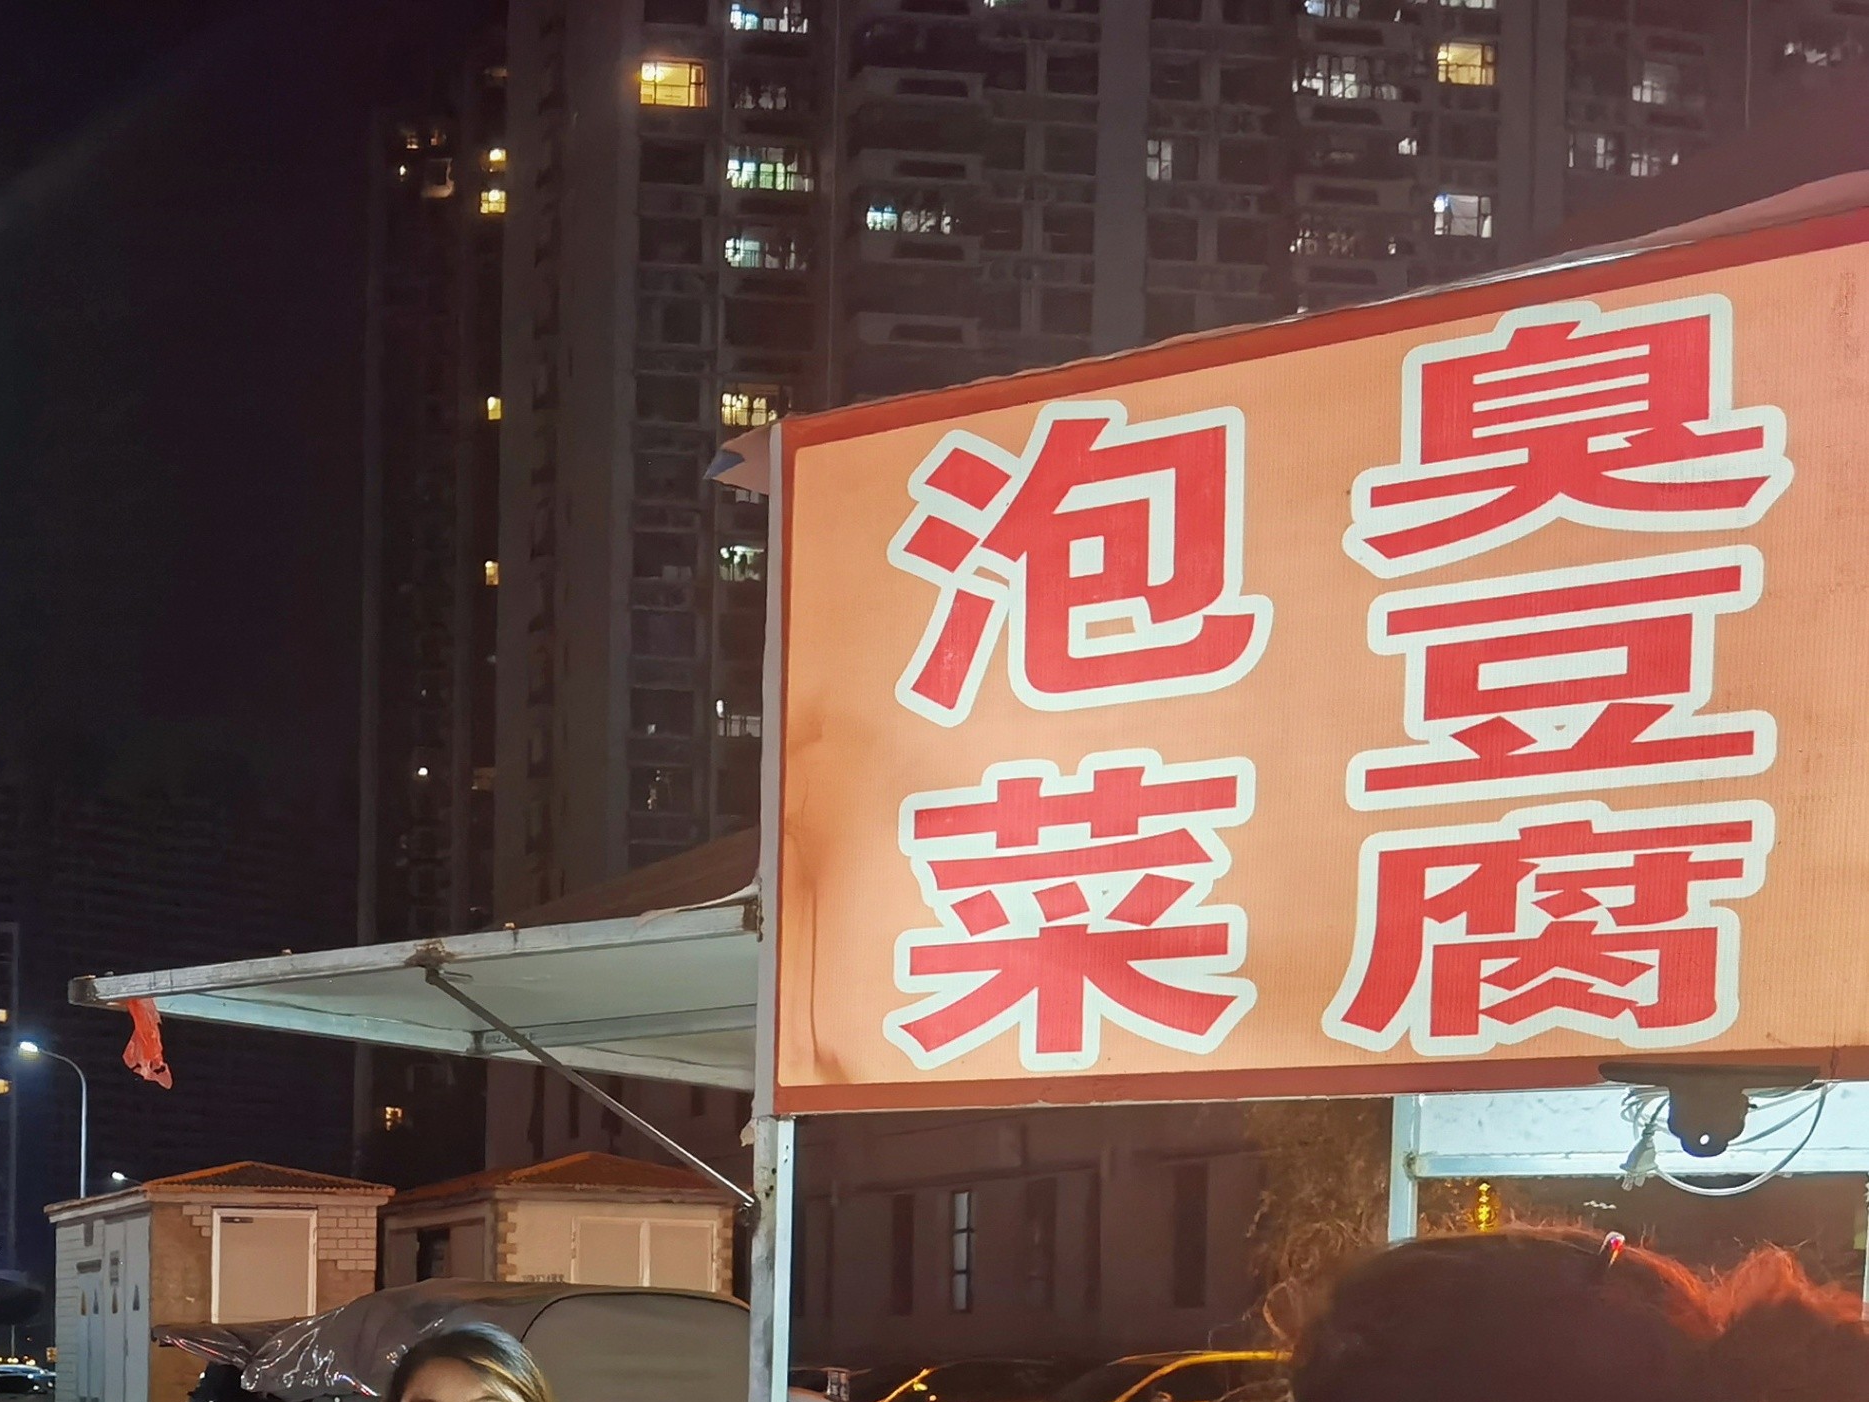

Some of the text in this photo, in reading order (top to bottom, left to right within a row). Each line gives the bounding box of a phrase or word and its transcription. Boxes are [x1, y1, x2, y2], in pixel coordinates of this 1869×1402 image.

[885, 401, 1272, 1069] 泡菜
[1325, 295, 1792, 1054] 臭豆腐
